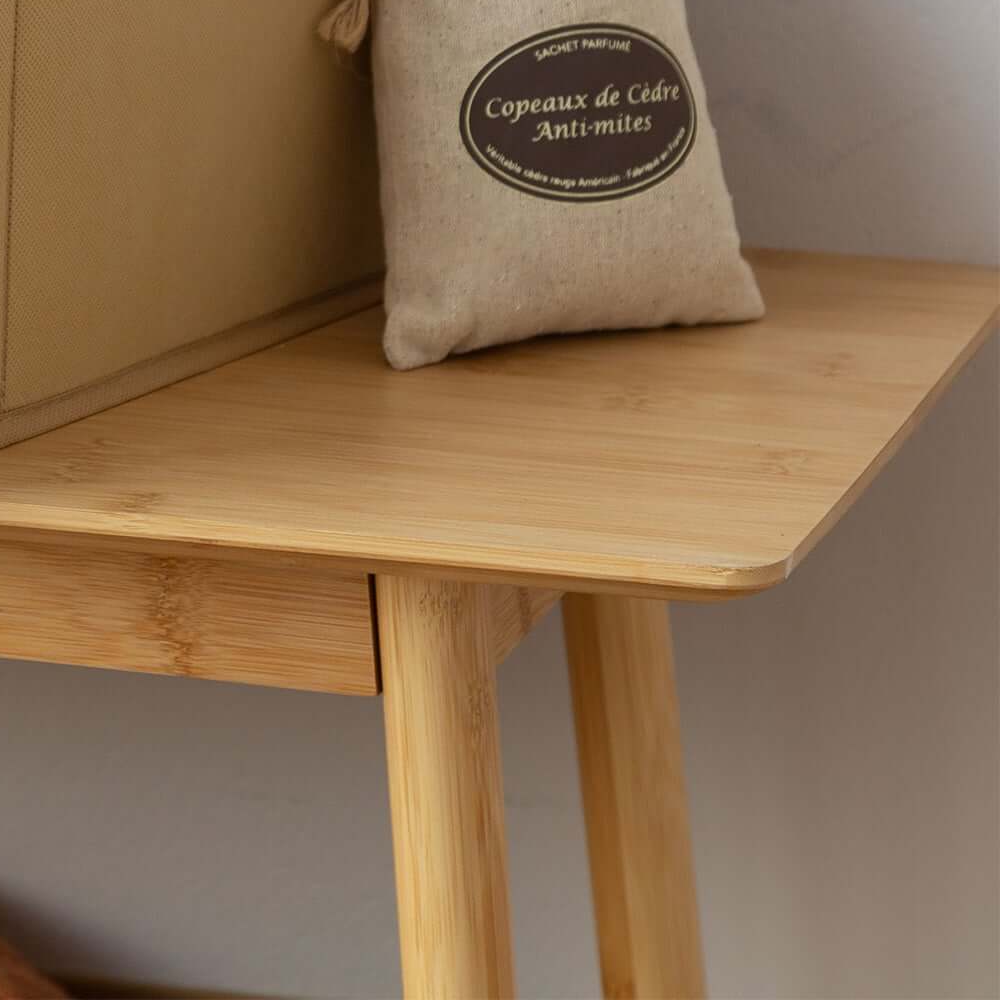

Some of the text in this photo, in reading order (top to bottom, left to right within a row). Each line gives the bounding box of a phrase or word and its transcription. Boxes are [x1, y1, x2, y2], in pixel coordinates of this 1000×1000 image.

[535, 40, 579, 61] SACHET
[485, 78, 681, 124] Copeaux de Cèdre
[531, 113, 653, 142] Anti-mites
